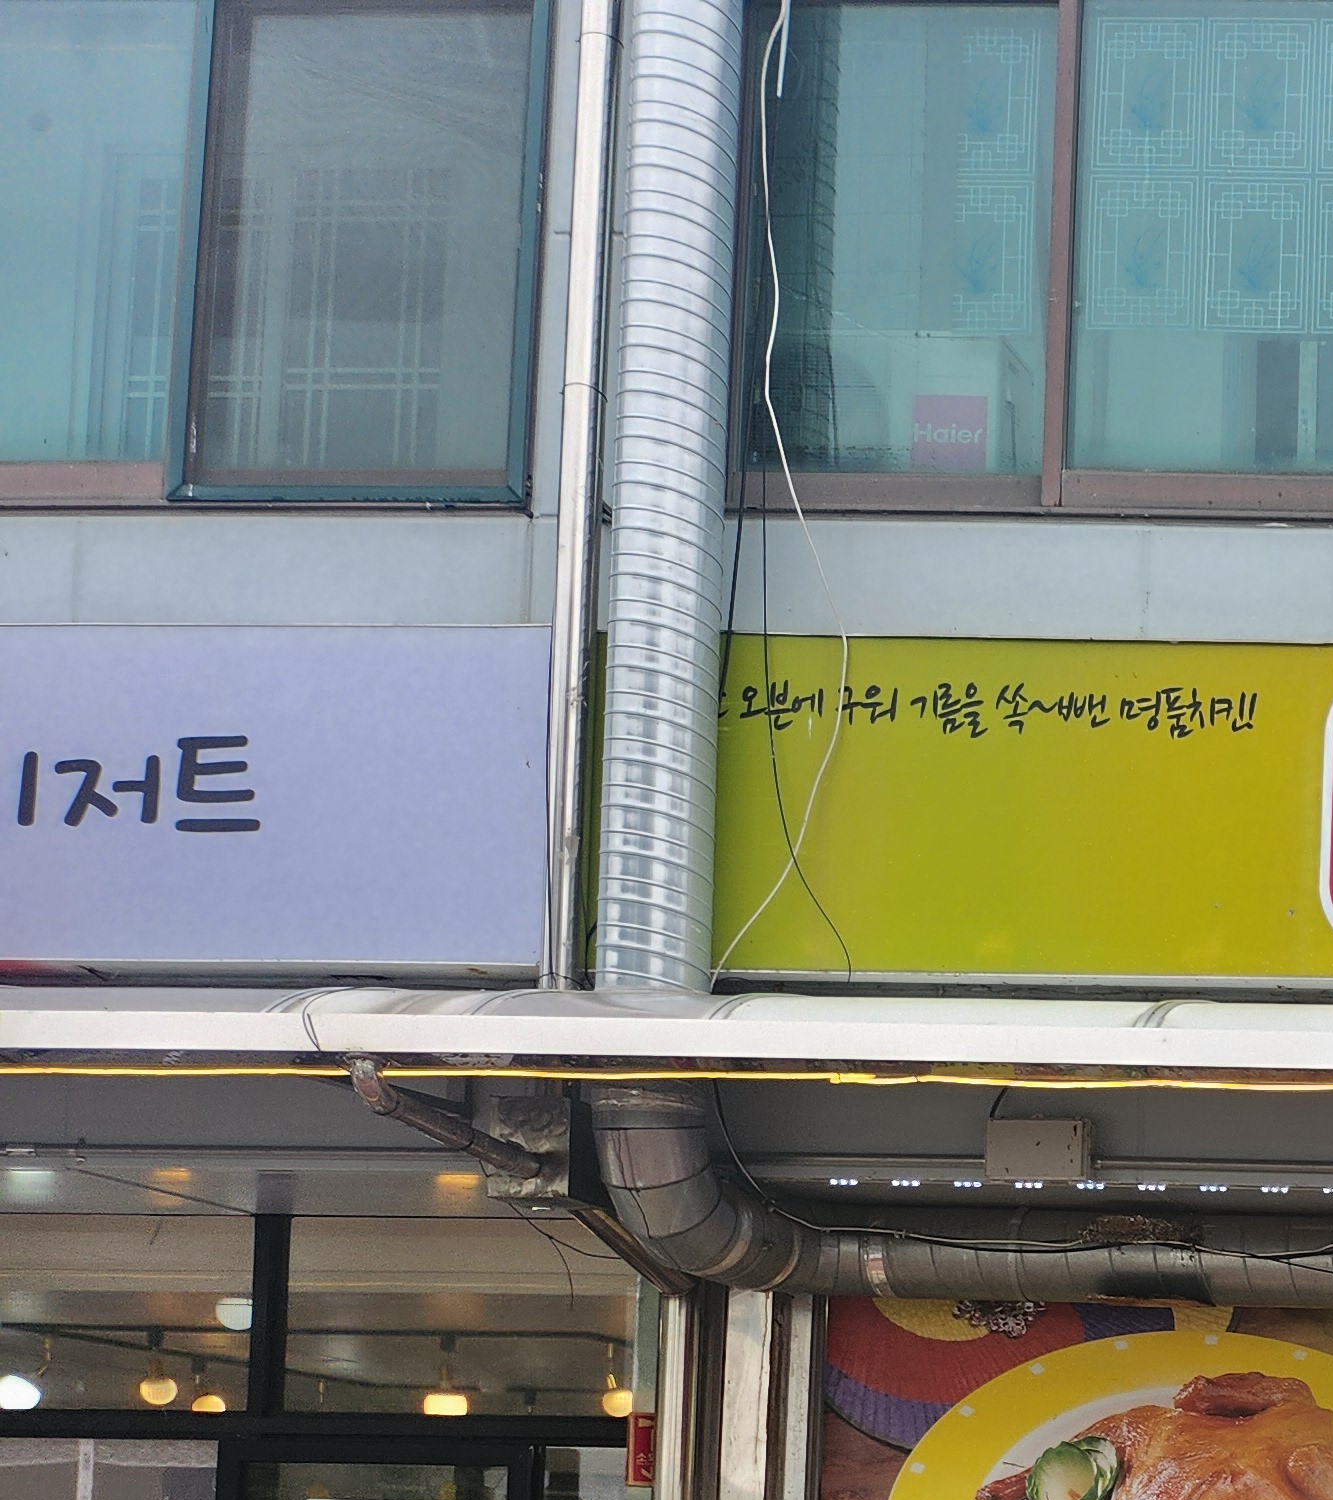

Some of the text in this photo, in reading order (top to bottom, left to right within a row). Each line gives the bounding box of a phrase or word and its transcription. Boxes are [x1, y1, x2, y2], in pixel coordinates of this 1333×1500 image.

[913, 423, 983, 444] Haier
[741, 679, 823, 731] 오븐에
[910, 681, 989, 739] 기름을
[20, 733, 263, 836] 저트
